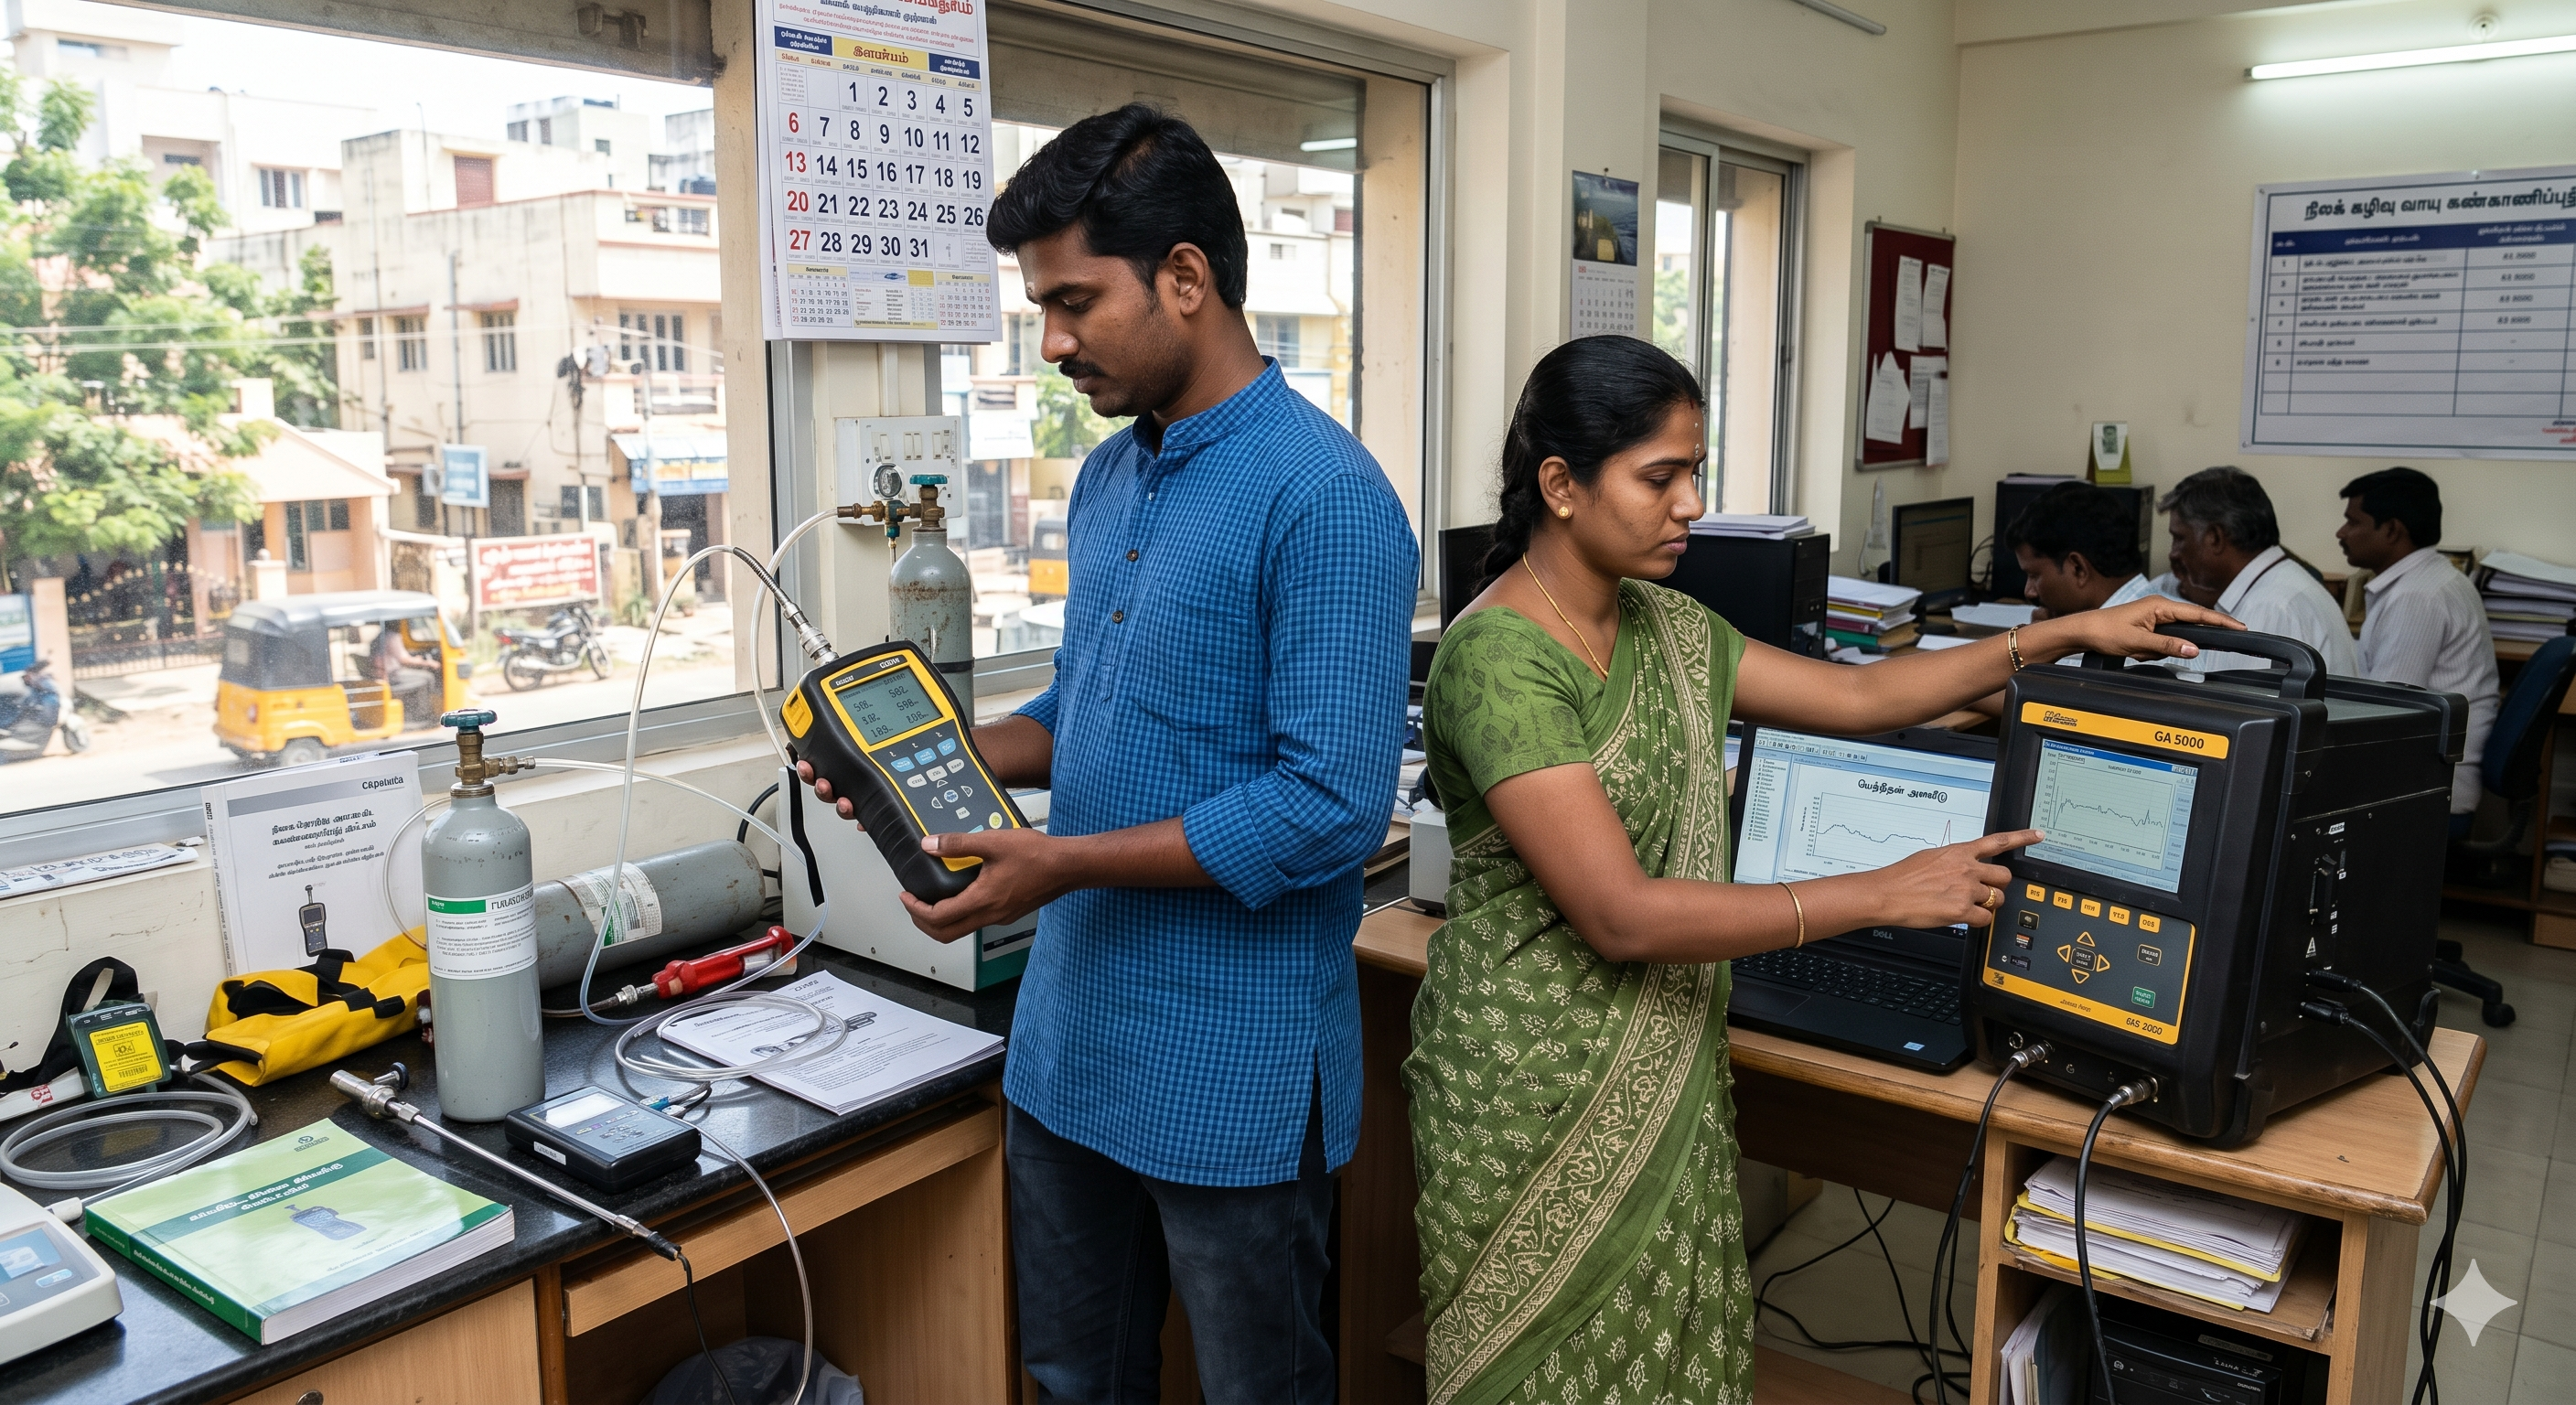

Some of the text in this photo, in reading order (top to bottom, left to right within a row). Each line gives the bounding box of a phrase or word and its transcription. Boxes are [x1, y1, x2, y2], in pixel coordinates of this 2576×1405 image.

[849, 81, 973, 118] 1 2 3 4 5
[789, 112, 980, 155] 6 7 8 9 10 11 12
[786, 151, 982, 190] 13 14 15 16 17 18 19
[787, 190, 984, 227] 20 21 22 23 24 25 26
[2351, 197, 2396, 219] கழிவு
[2400, 198, 2442, 214] வாயு
[789, 229, 928, 258] 27 28 29 30 31
[2154, 731, 2205, 749] GA 5000
